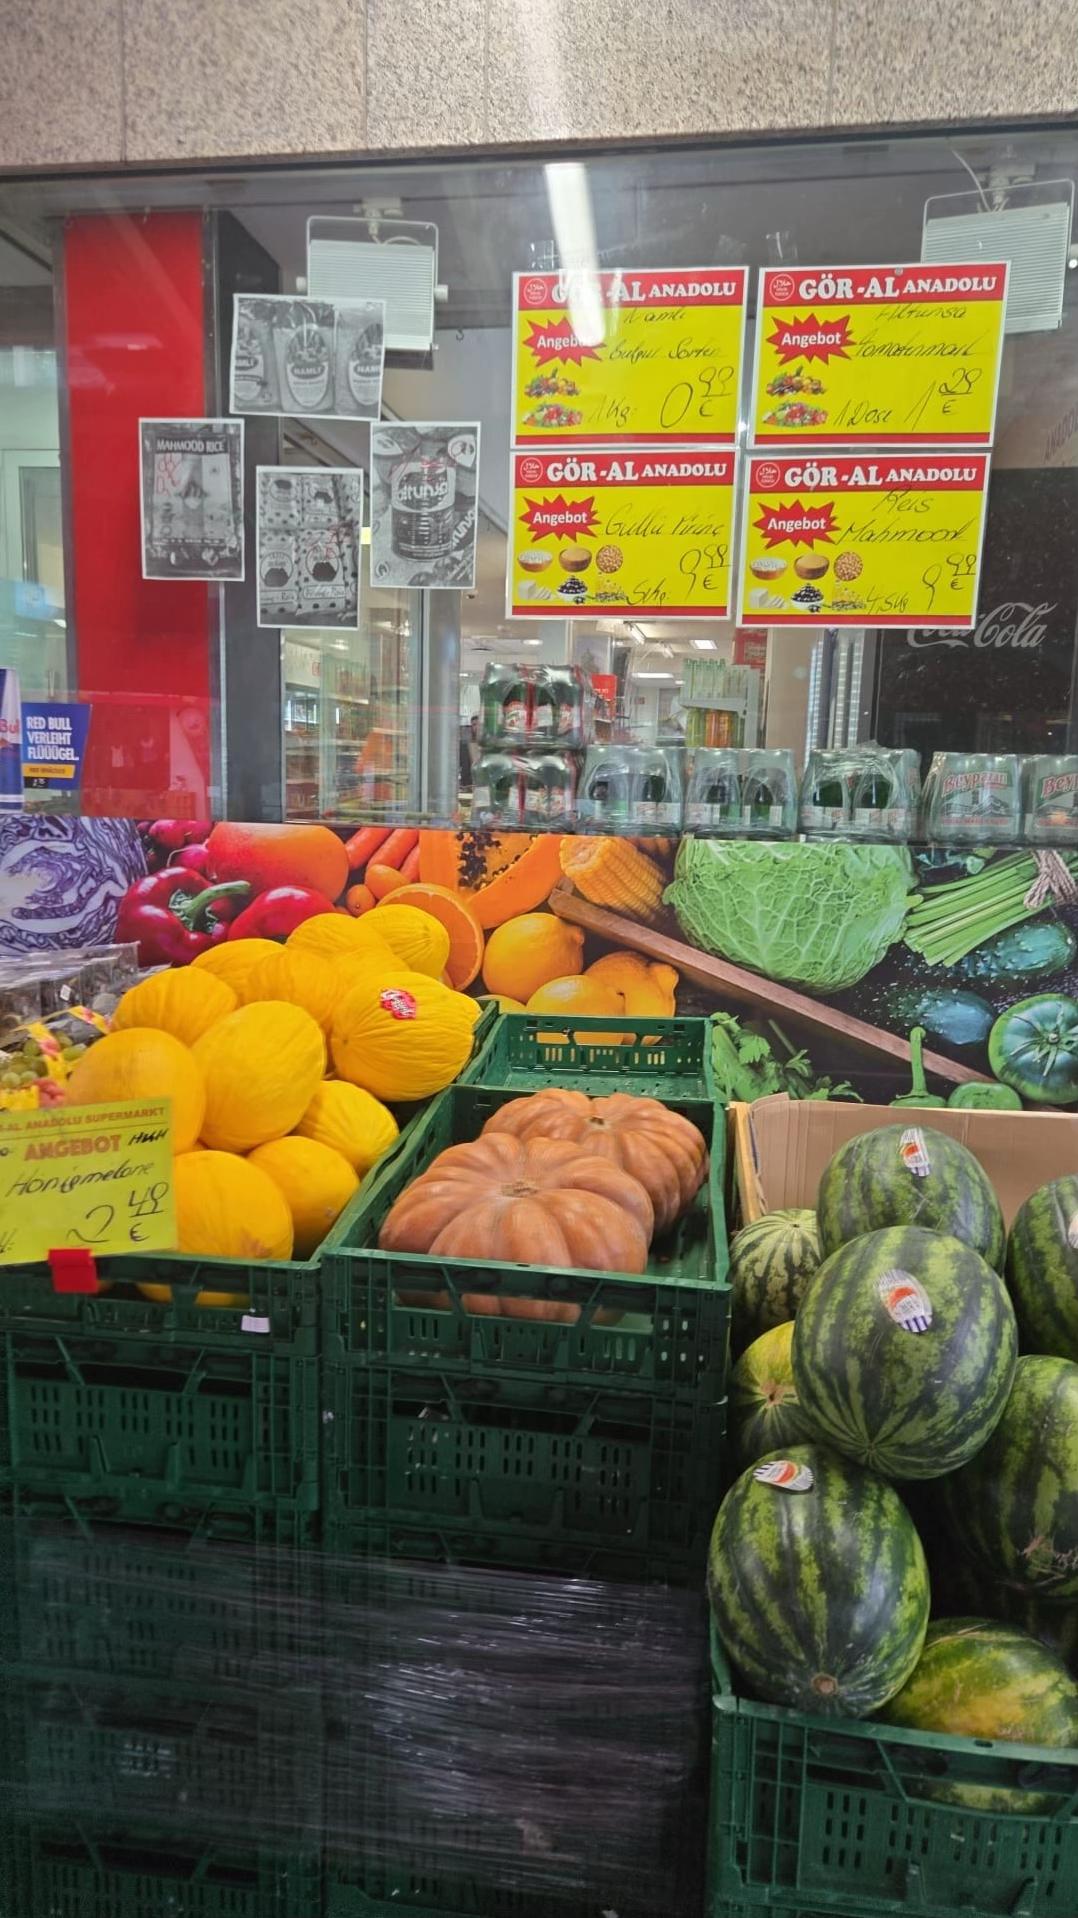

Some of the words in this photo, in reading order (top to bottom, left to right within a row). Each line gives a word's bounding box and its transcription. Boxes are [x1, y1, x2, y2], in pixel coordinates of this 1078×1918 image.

[649, 282, 736, 298] ANADOLU
[902, 276, 997, 294] ANADOLU
[537, 335, 594, 350] Angeb
[781, 332, 842, 348] Angebot
[157, 439, 204, 452] MAHMOOD
[206, 440, 224, 452] RICE
[642, 463, 727, 478] ANADOLU
[886, 468, 977, 482] ANADOLU
[533, 511, 587, 526] Angebot
[767, 517, 826, 533] Angebot
[26, 716, 46, 730] RED
[48, 716, 73, 730] BULL
[27, 731, 72, 745] VERLEIHT
[26, 1117, 82, 1129] ANADOLU
[85, 1107, 165, 1124] SUPERMARKT
[25, 1134, 121, 1161] ANGEBOT
[67, 1204, 115, 1243] 2
[129, 1222, 150, 1242] €
